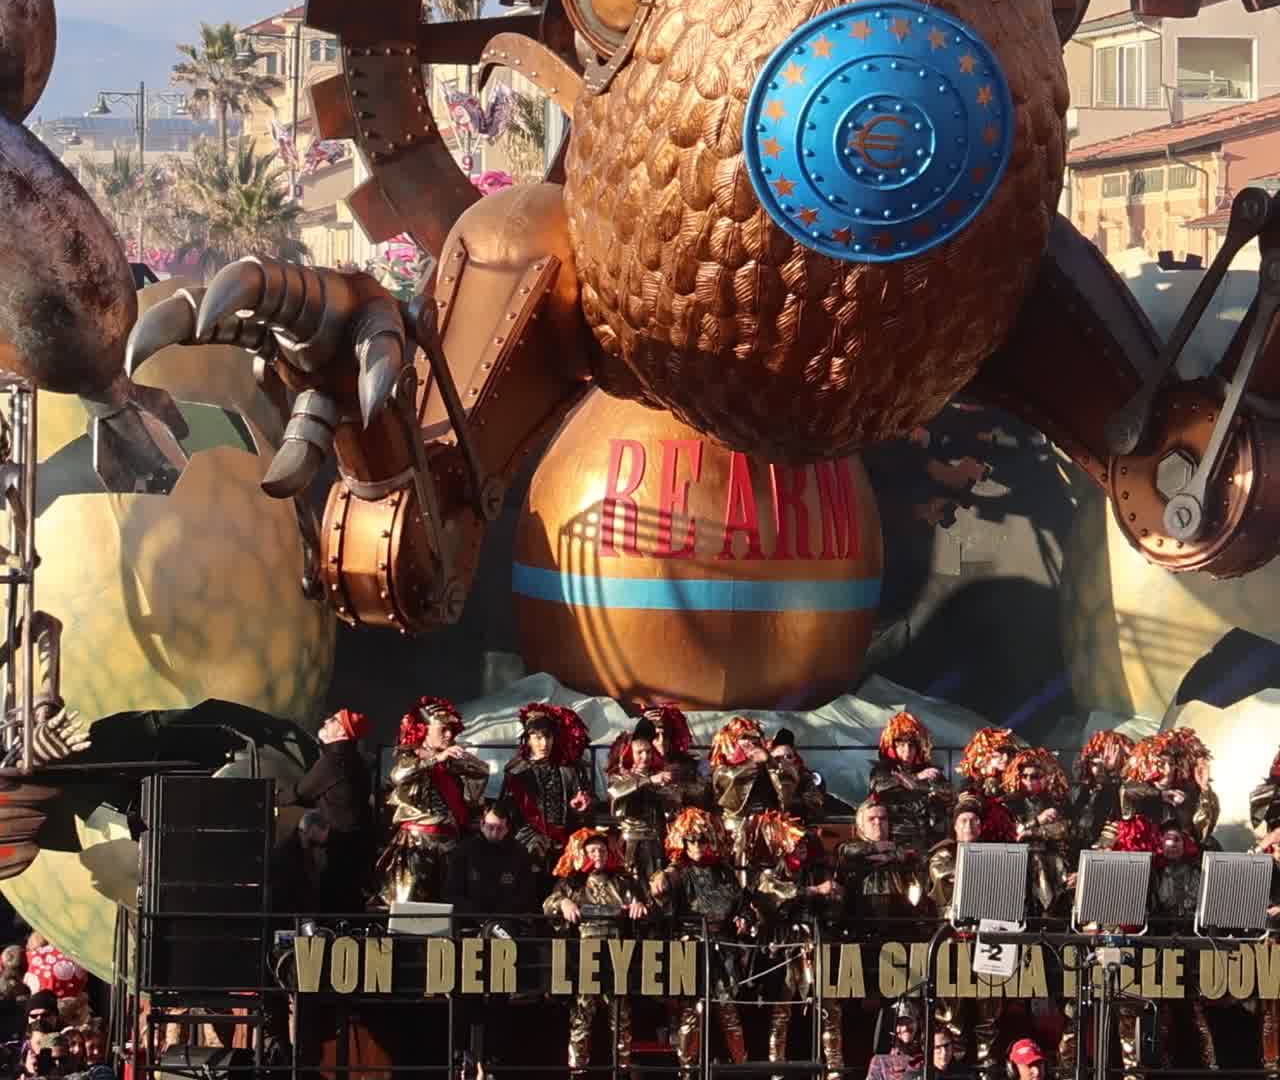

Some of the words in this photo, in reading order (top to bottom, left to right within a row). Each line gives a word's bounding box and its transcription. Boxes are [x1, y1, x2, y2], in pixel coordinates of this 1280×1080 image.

[294, 936, 392, 993] VON
[424, 936, 517, 995] DER
[551, 938, 697, 995] LEYEN
[821, 943, 865, 998] LA
